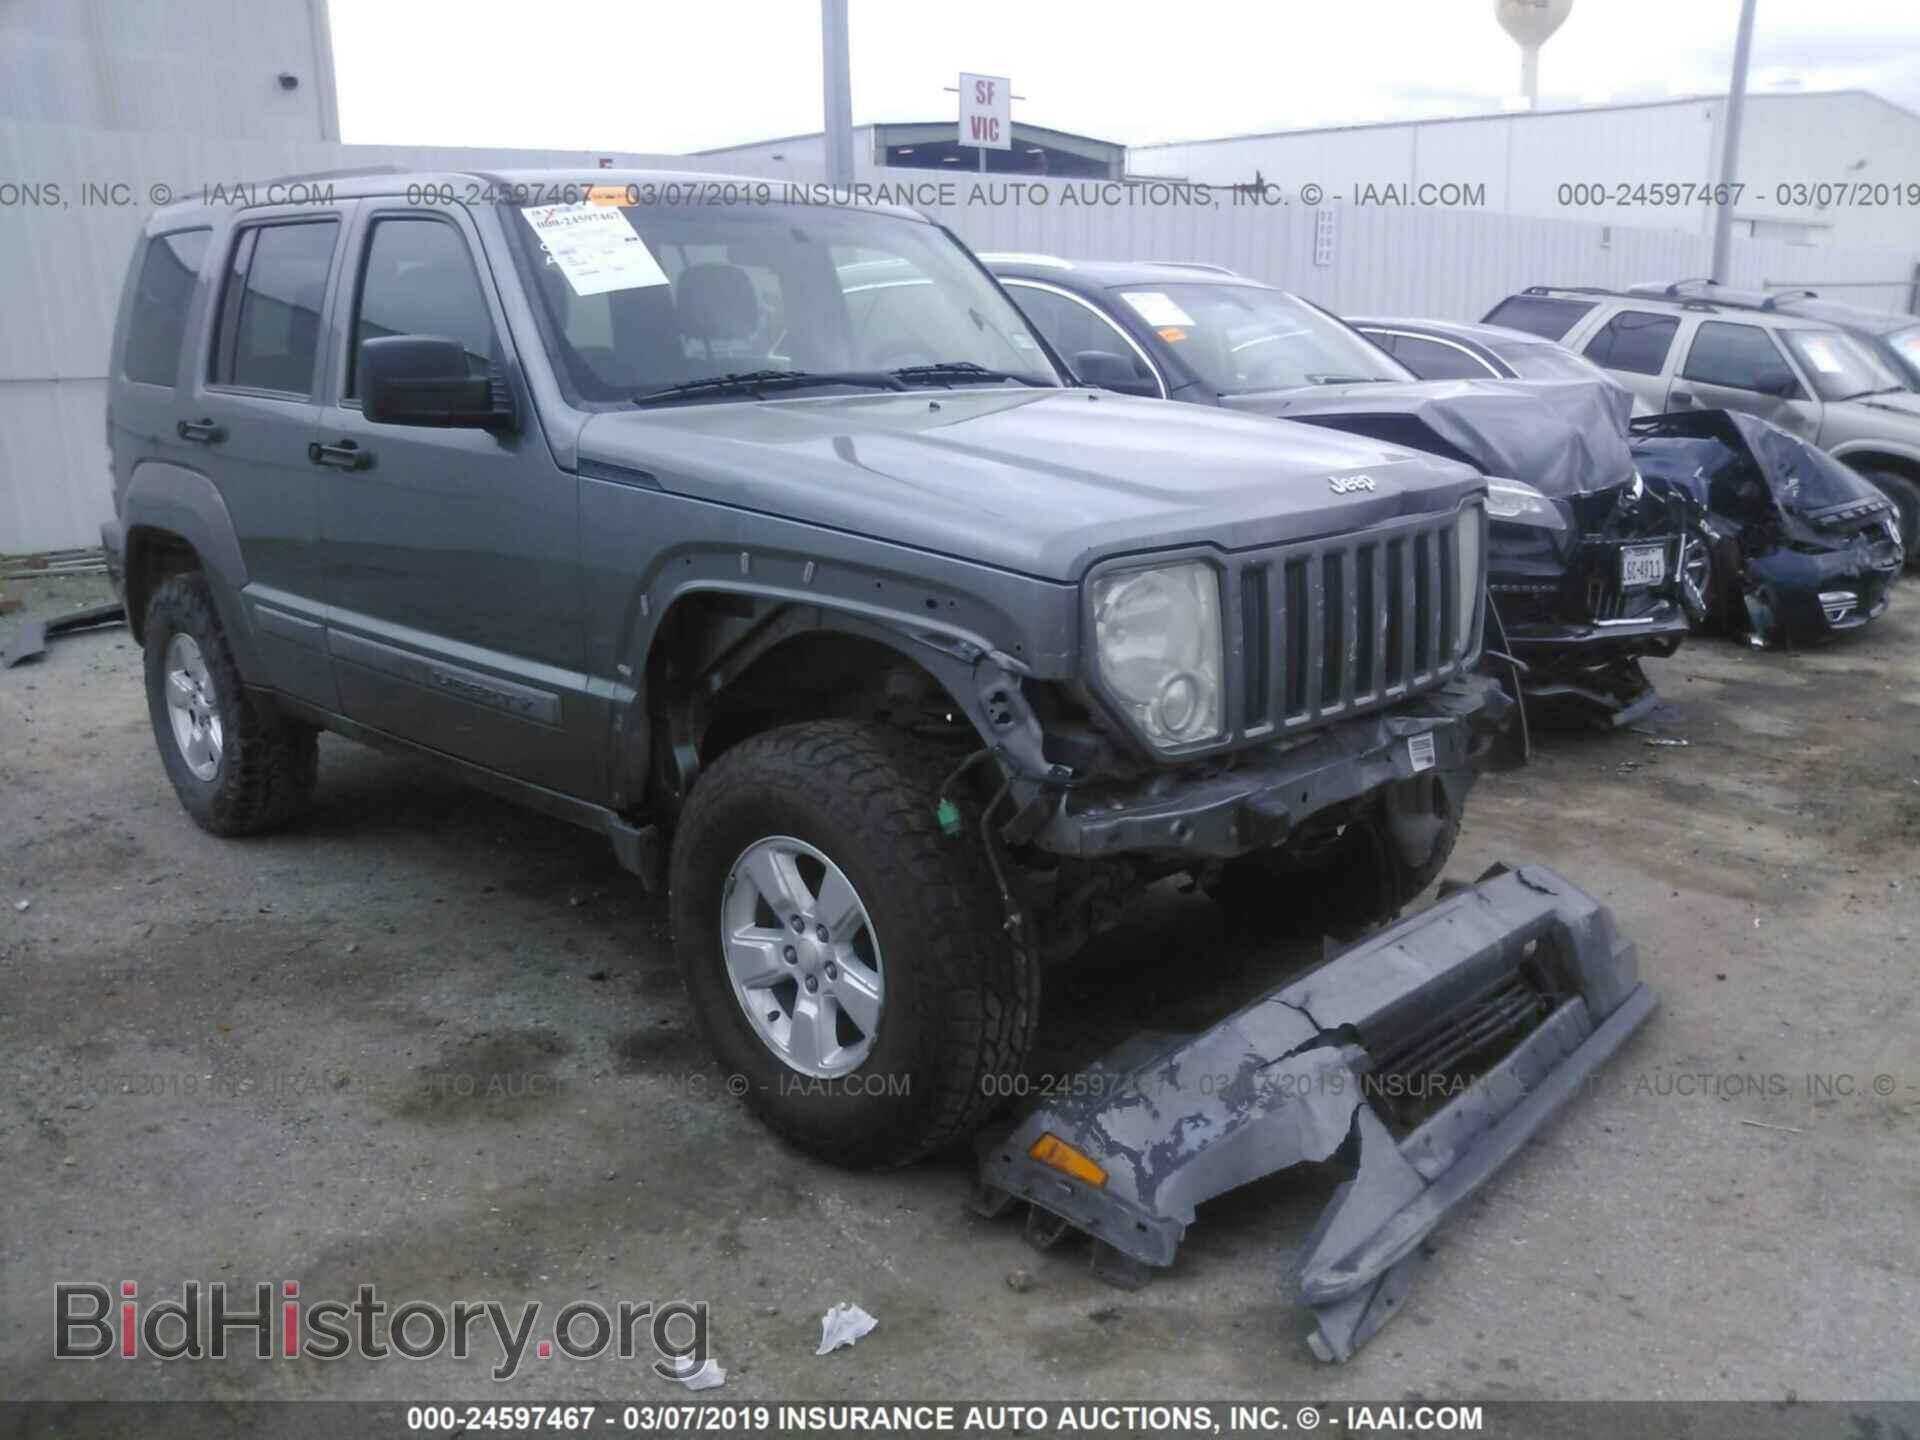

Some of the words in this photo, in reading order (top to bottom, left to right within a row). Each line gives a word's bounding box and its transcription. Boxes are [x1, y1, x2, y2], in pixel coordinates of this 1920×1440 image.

[975, 79, 995, 105] SF
[970, 115, 1000, 142] VIC
[1328, 475, 1376, 494] Jeep
